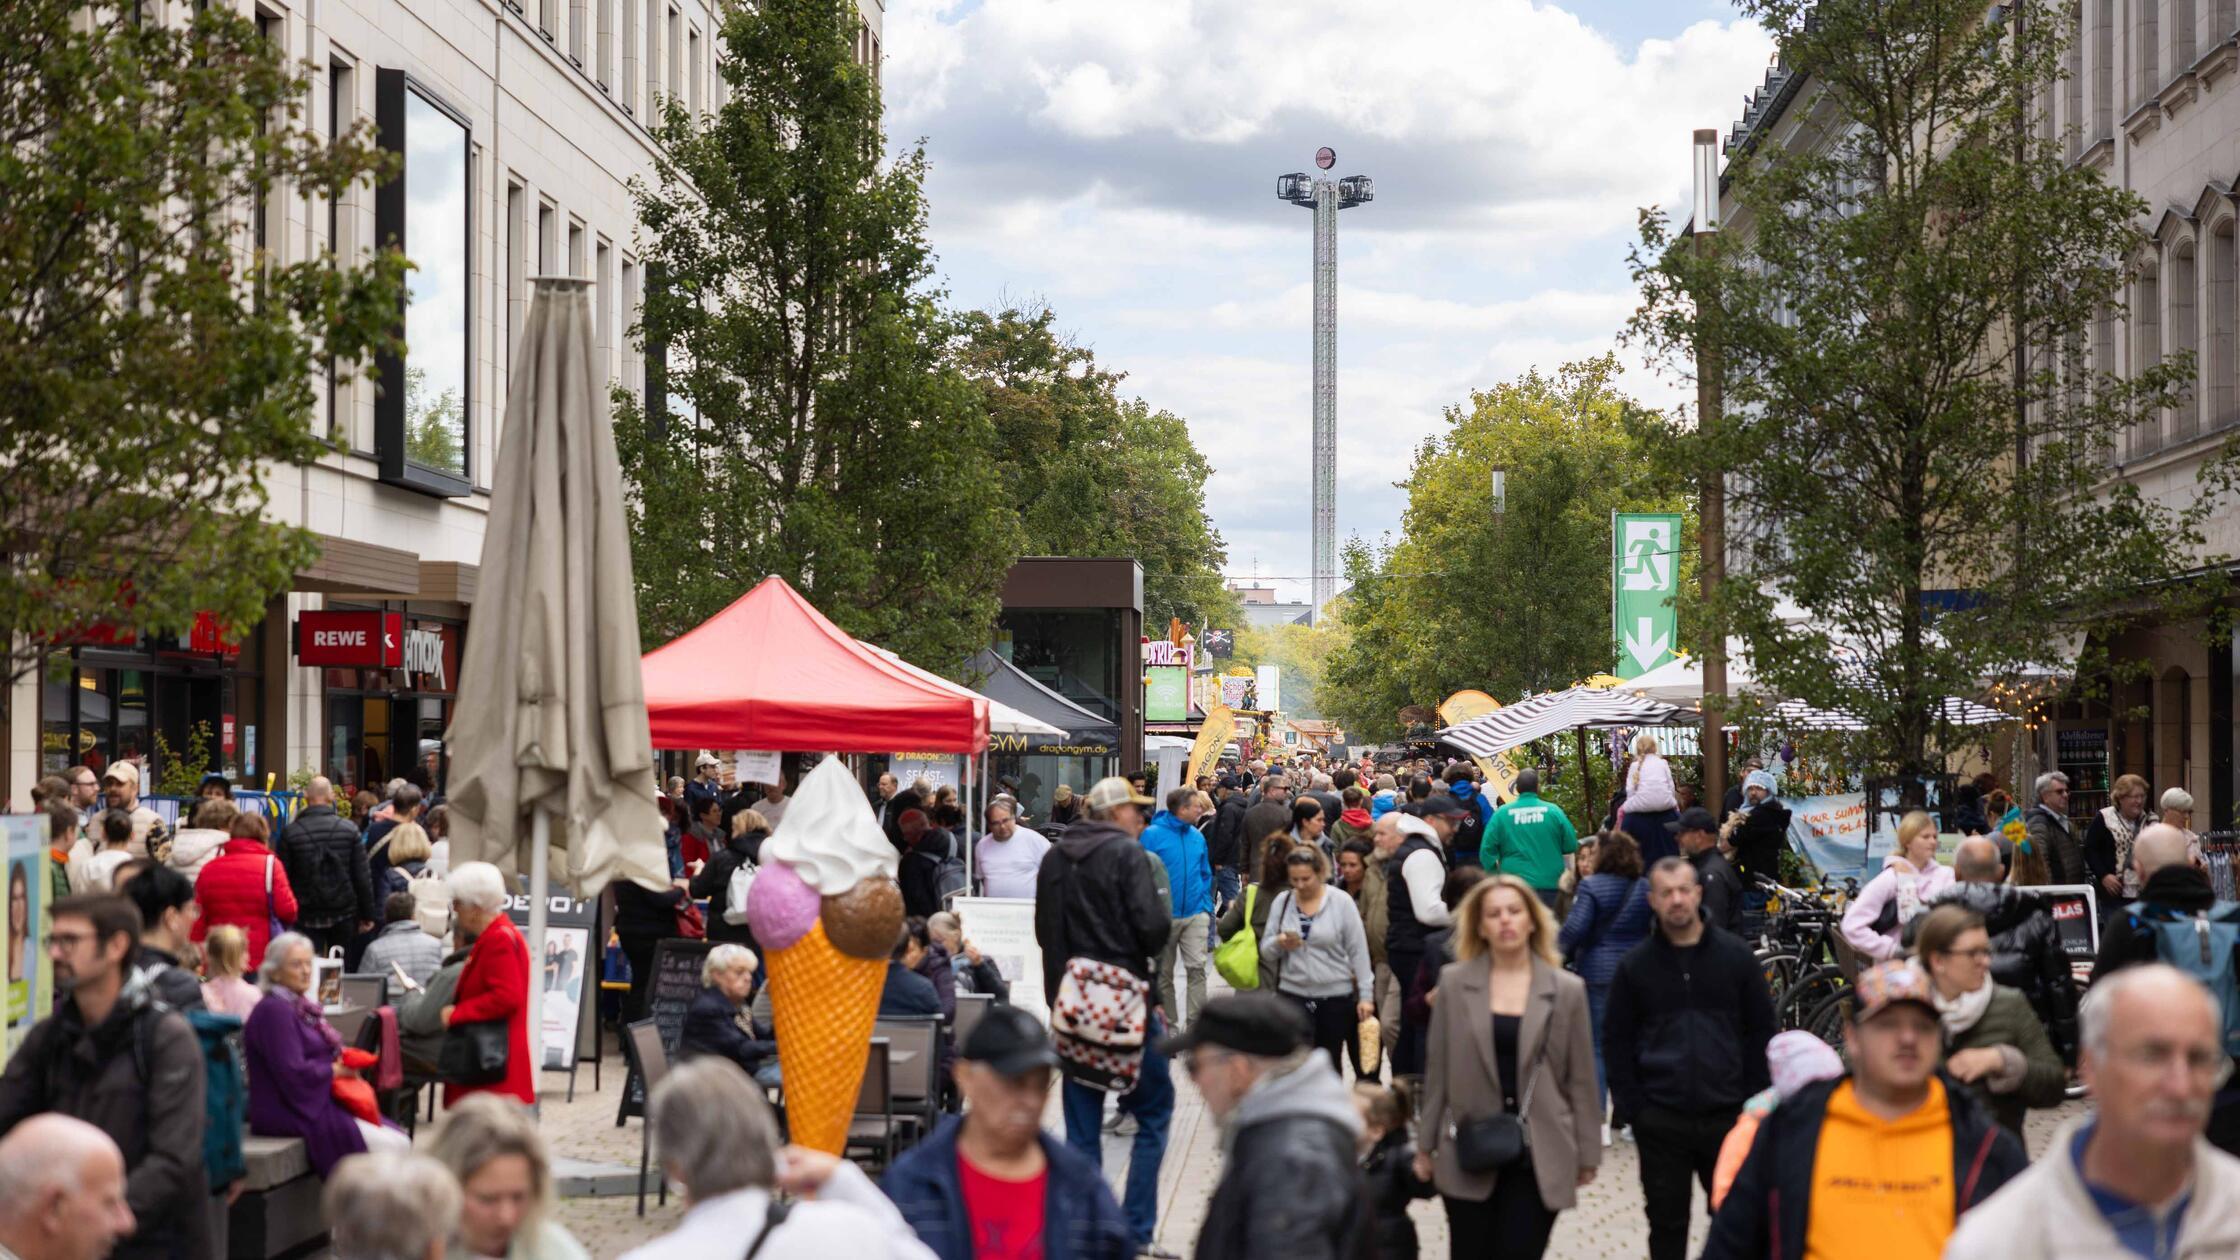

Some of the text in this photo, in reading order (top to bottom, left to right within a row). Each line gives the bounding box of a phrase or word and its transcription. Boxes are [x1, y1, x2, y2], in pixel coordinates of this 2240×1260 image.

[314, 631, 366, 646] REWE
[989, 734, 1027, 751] GYM
[1040, 743, 1107, 754] dragongym.de
[1834, 804, 1866, 820] SUMM
[1811, 827, 1824, 837] IN
[1839, 817, 1867, 833] GLAS
[499, 893, 591, 914] DEOT
